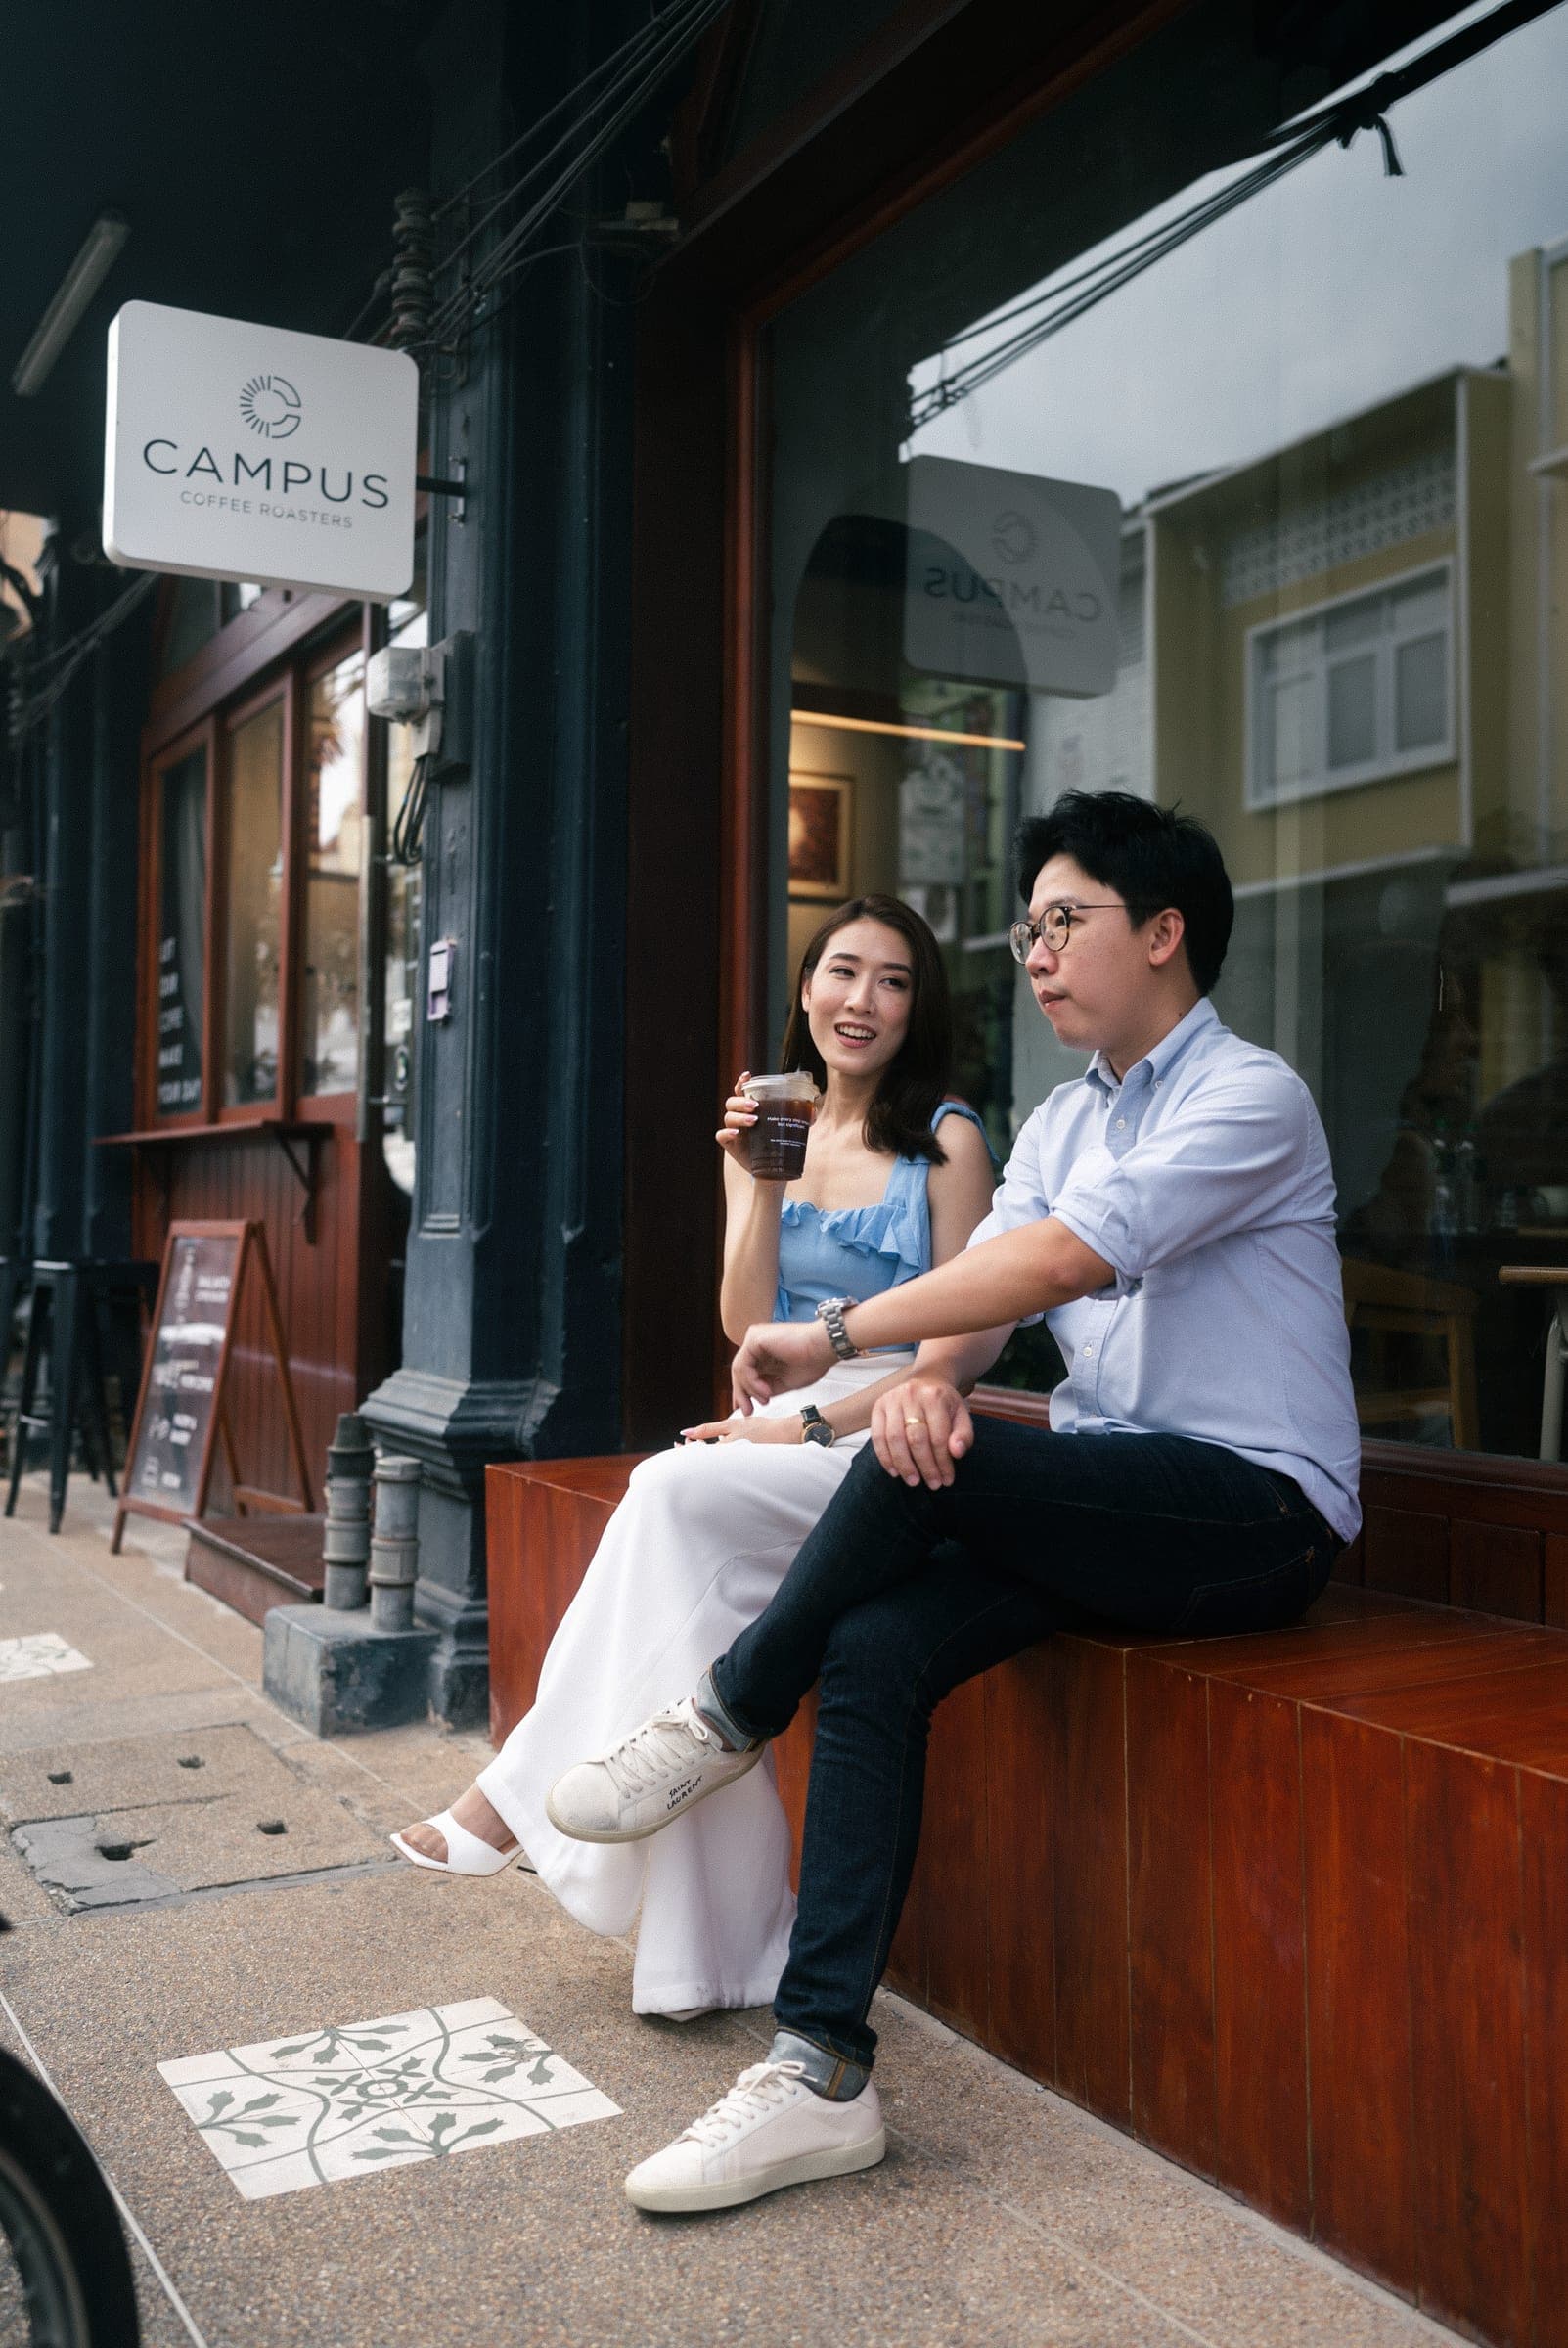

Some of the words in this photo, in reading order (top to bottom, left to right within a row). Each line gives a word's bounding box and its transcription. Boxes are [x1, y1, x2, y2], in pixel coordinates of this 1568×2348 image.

[143, 439, 388, 509] CAMPUS
[180, 490, 252, 514] COFFEE
[259, 503, 353, 528] ROASTERS
[667, 1775, 702, 1810] LAURENT
[669, 1779, 691, 1798] SAINT
